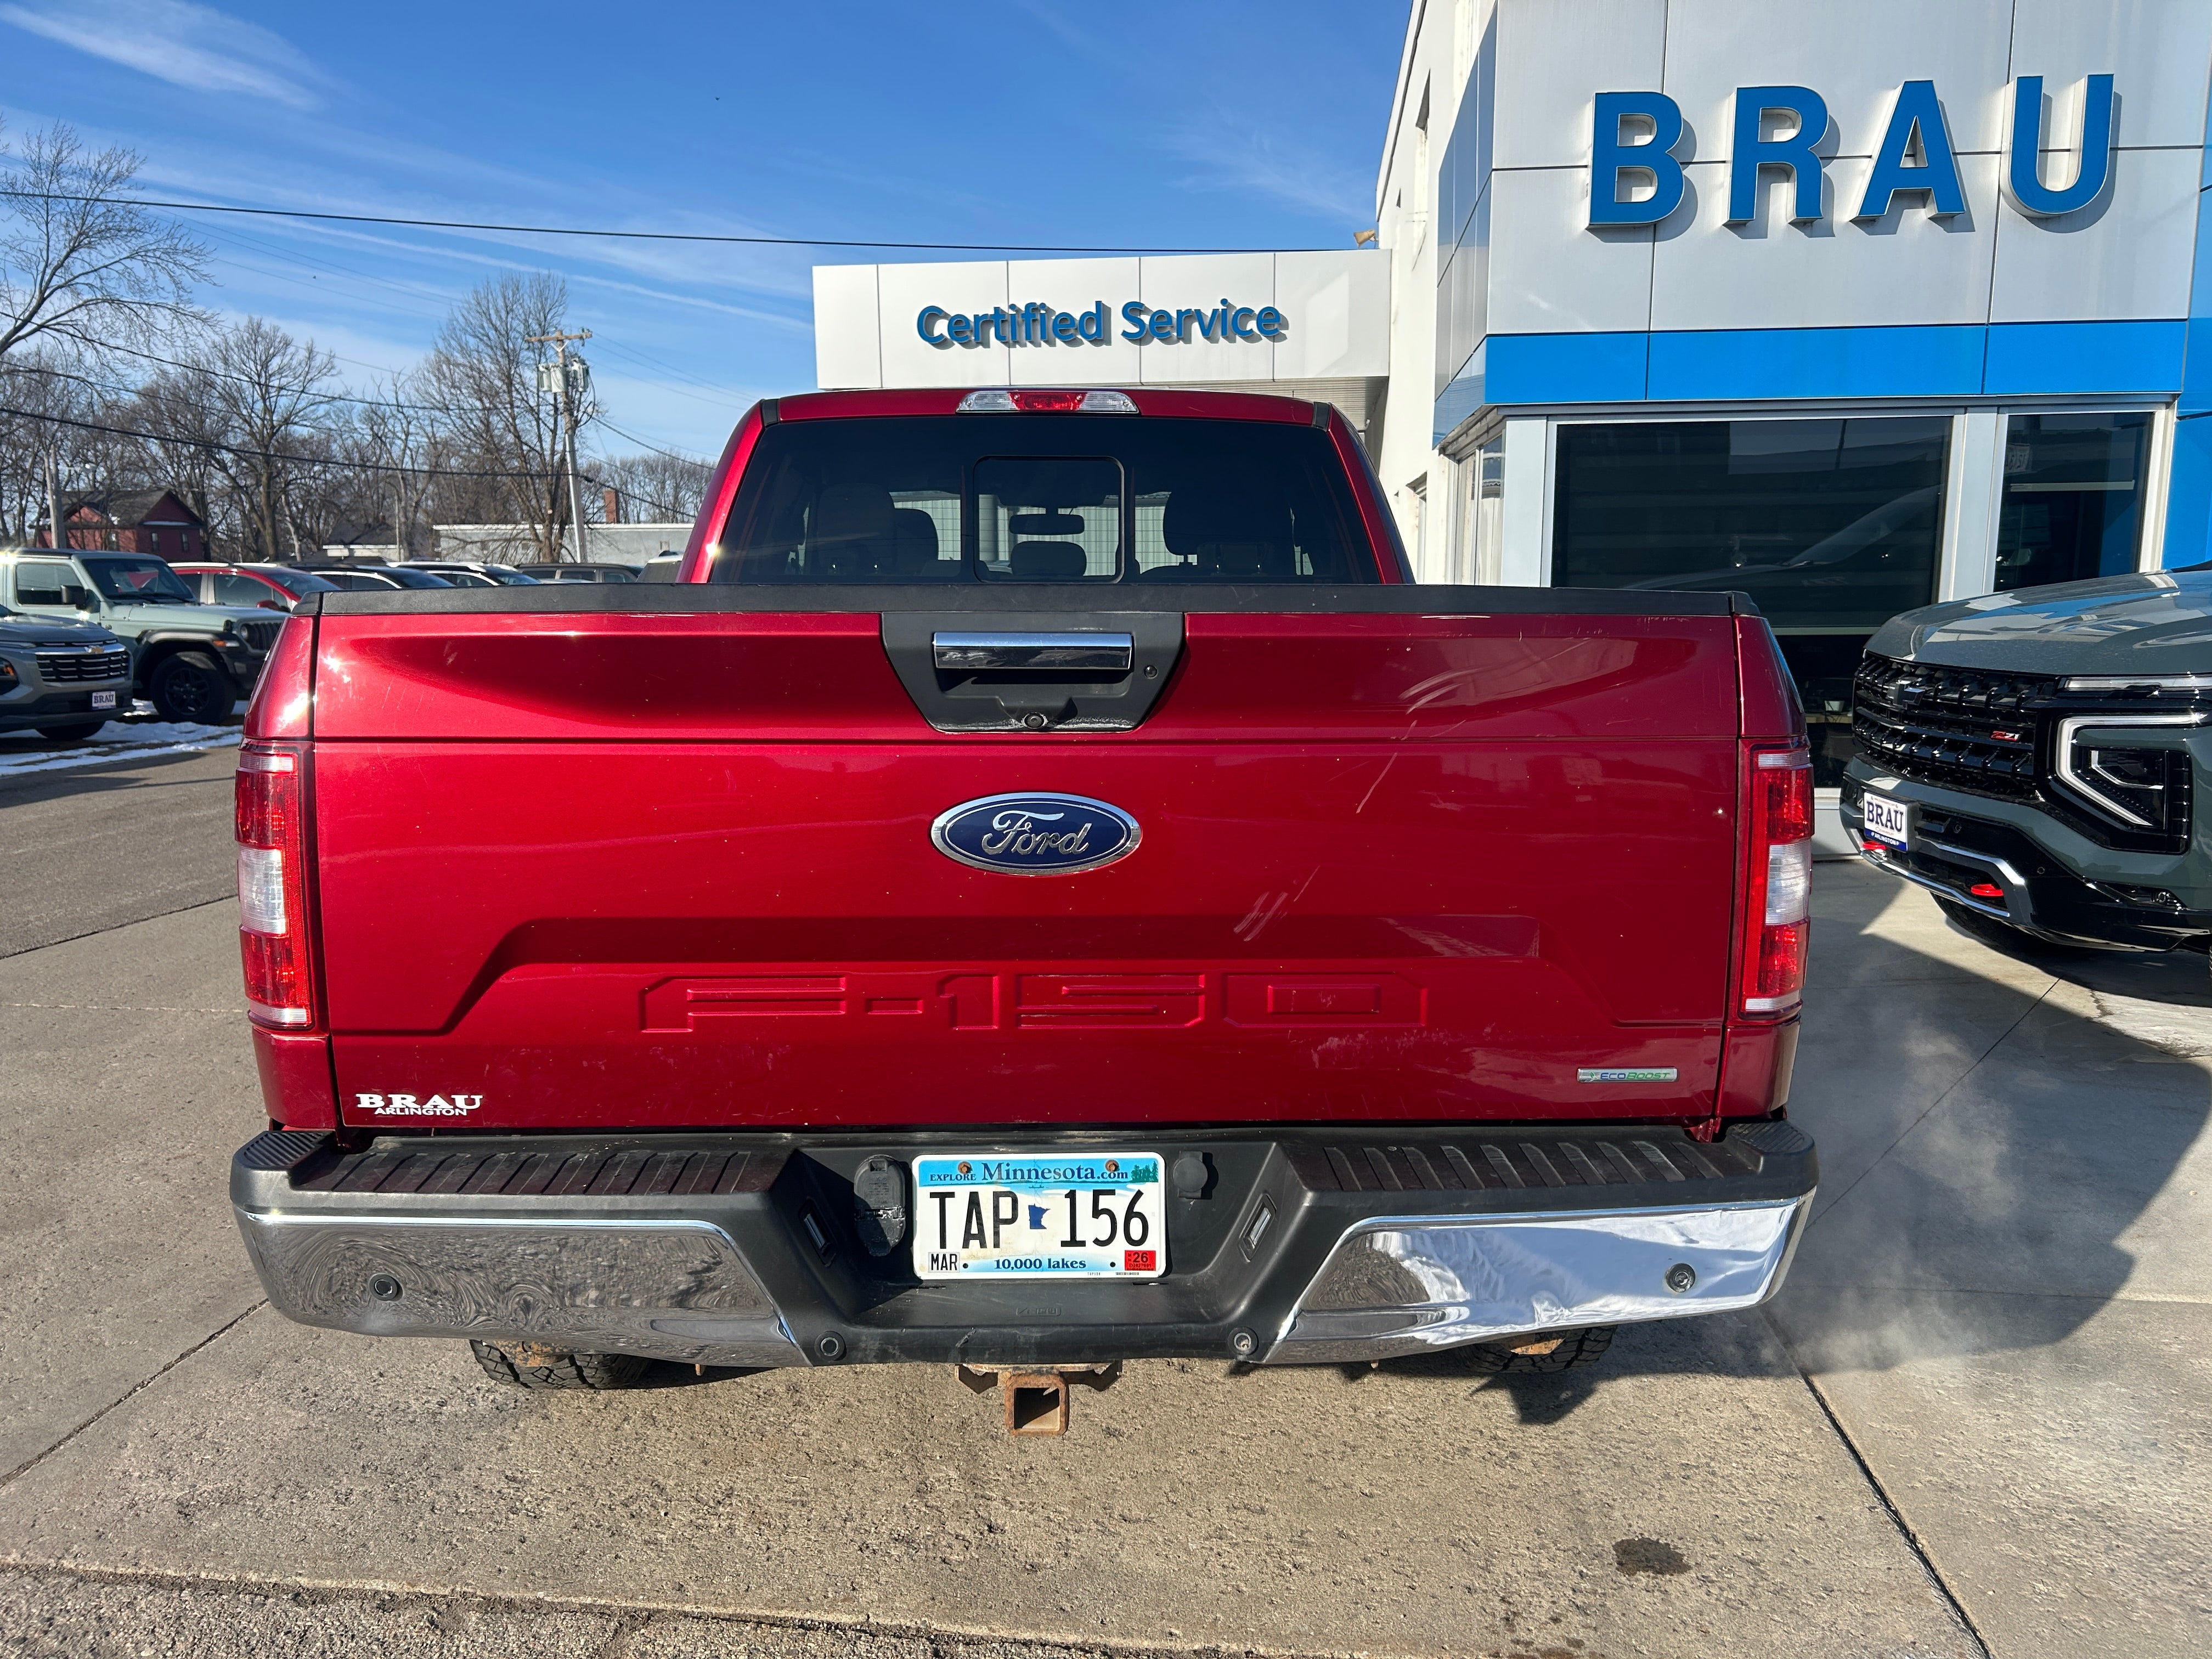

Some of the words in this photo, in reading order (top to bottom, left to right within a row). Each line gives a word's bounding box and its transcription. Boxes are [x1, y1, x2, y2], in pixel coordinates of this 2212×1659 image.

[1588, 74, 2115, 228] BRAU
[917, 300, 1103, 345] Certified
[1121, 298, 1282, 340] Service
[94, 694, 114, 704] BRAU
[1866, 800, 1904, 832] BRAU
[981, 810, 1092, 855] Ford
[641, 974, 1427, 1034] F-150
[356, 1093, 483, 1109] BRAU
[374, 1107, 467, 1115] ARLINGTON
[981, 1161, 1128, 1180] Minnesota.com
[930, 1190, 1019, 1249] TAP
[1060, 1189, 1149, 1247] 156
[931, 1253, 958, 1271] MAR
[994, 1258, 1042, 1270] 10,000
[1047, 1257, 1086, 1269] lakes
[1133, 1249, 1149, 1263] 26
